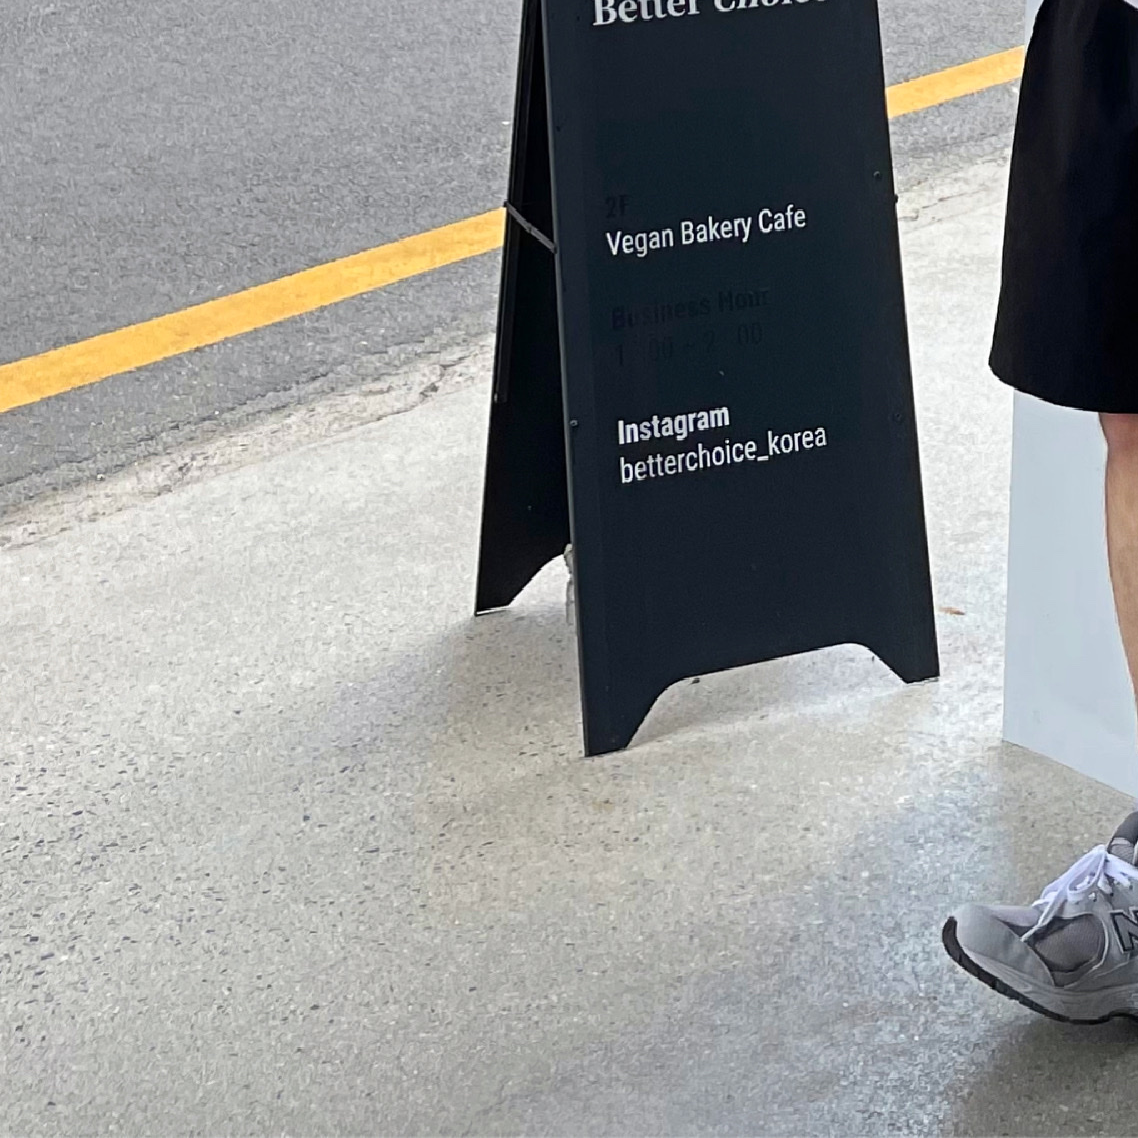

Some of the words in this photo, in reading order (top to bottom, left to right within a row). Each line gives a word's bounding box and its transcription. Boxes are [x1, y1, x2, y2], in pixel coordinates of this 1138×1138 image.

[606, 228, 674, 257] Vegan
[681, 216, 752, 243] Bakery
[758, 204, 806, 233] Cafe
[617, 406, 730, 445] Instagram
[619, 426, 827, 483] betterchoice_korea
